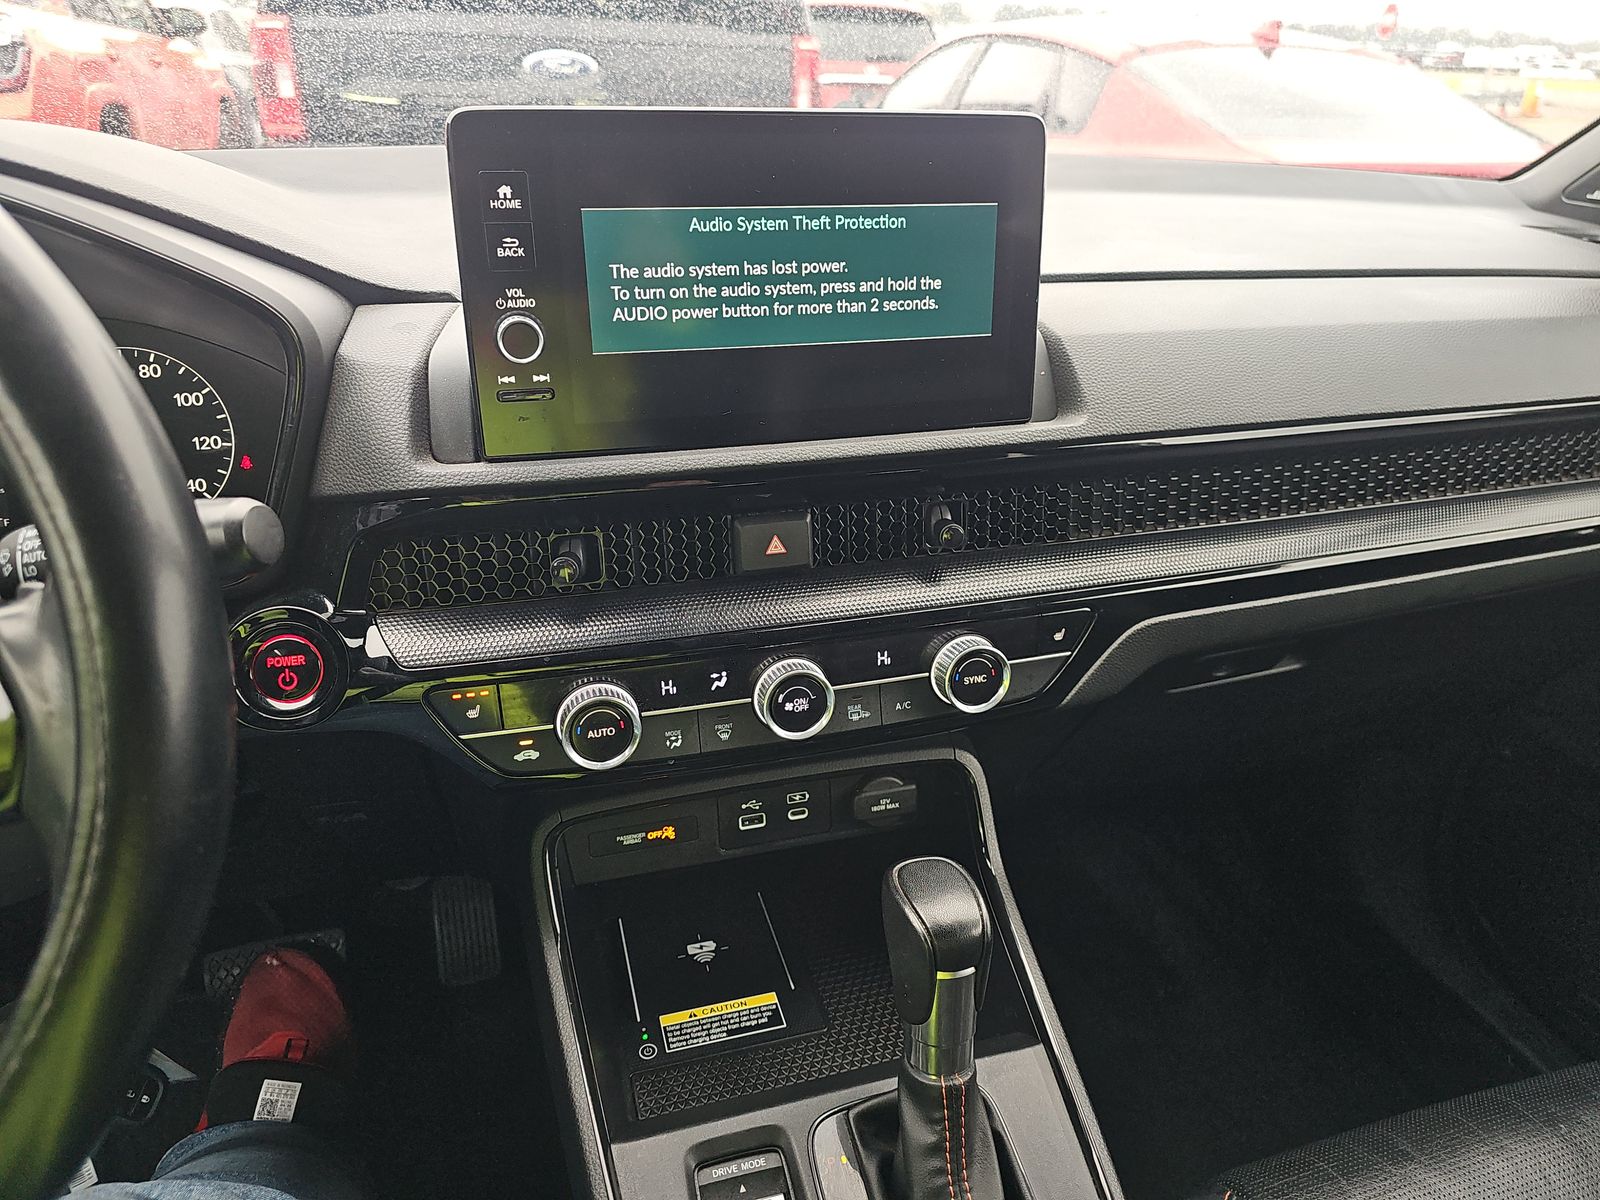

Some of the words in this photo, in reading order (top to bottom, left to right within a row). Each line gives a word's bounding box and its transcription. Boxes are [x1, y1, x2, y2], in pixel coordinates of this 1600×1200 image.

[489, 199, 522, 209] HOME
[688, 216, 733, 232] Audio
[737, 216, 788, 234] System
[792, 214, 831, 231] Theft
[835, 213, 907, 230] Protection
[497, 247, 525, 257] BACK
[609, 263, 639, 279] The
[643, 262, 685, 278] audio
[688, 262, 740, 280] system
[743, 260, 768, 276] has
[772, 259, 798, 275] lost
[801, 261, 849, 277] power.
[505, 288, 525, 298] VOL
[610, 285, 630, 301] To
[634, 285, 665, 300] turn
[669, 286, 689, 299] on
[693, 283, 717, 298] the
[720, 281, 760, 297] audio
[764, 281, 817, 299] system,
[820, 282, 856, 296] press
[859, 277, 884, 292] and
[887, 276, 917, 292] hold
[920, 275, 942, 290] the
[507, 298, 536, 308] AUDIO
[612, 305, 668, 322] AUDIO
[672, 307, 719, 322] power
[722, 303, 769, 318] button
[773, 302, 794, 316] for
[797, 302, 833, 315] more
[836, 299, 867, 313] than
[870, 297, 879, 312] 2
[883, 296, 939, 311] seconds.
[138, 364, 162, 378] 80
[173, 392, 204, 407] 100
[191, 435, 222, 450] 120
[186, 478, 207, 492] 40
[23, 565, 38, 577] LO
[266, 655, 306, 668] POWER
[963, 674, 988, 685] SYNC
[794, 698, 810, 706] ON/
[895, 701, 911, 711] A/C
[794, 704, 809, 713] OFF
[715, 722, 733, 730] FRONT
[587, 727, 616, 739] AUTO
[886, 802, 900, 810] MAX
[647, 830, 663, 840] OFF
[701, 1000, 748, 1016] CAUTION
[712, 1165, 739, 1178] DRIVE
[741, 1157, 767, 1172] MODE
